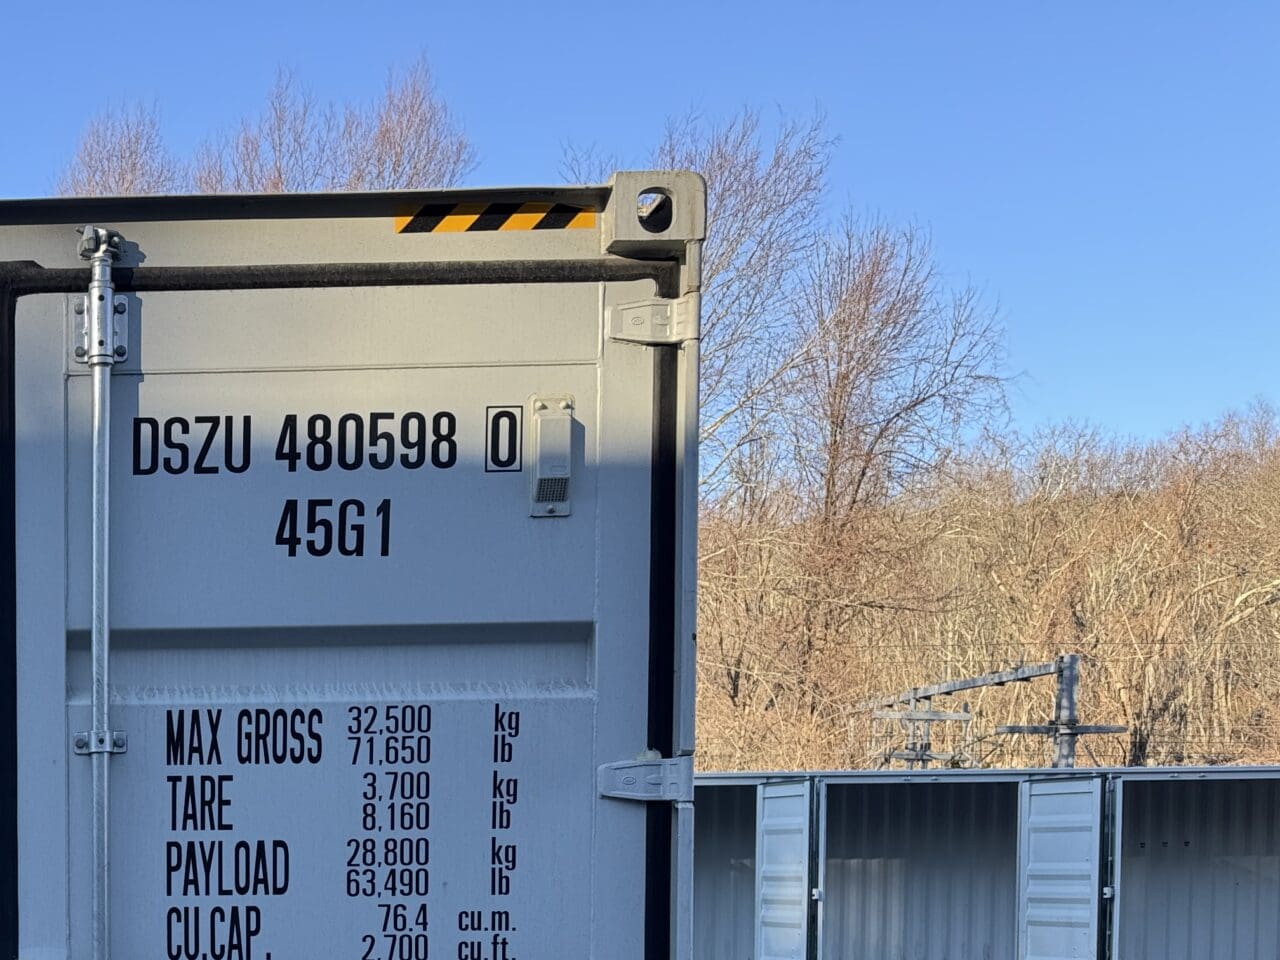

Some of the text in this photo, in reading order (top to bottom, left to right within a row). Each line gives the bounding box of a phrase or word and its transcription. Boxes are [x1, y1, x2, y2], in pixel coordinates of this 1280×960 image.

[133, 415, 251, 475] DSZU
[275, 411, 457, 472] 480598
[275, 499, 391, 556] 45G1
[167, 709, 322, 765] MAX GROSS
[348, 704, 520, 738] 32,500 kg
[348, 735, 512, 766] 71,650 lb
[167, 775, 233, 830] TARE
[363, 771, 518, 804] 3,700 kg
[362, 802, 511, 832] 8,160 lb
[167, 840, 289, 896] PAYLOAD
[347, 838, 516, 871] 28,800 kg
[346, 868, 509, 898] 63,490 lb
[378, 904, 516, 932] 76.4 cu.m.
